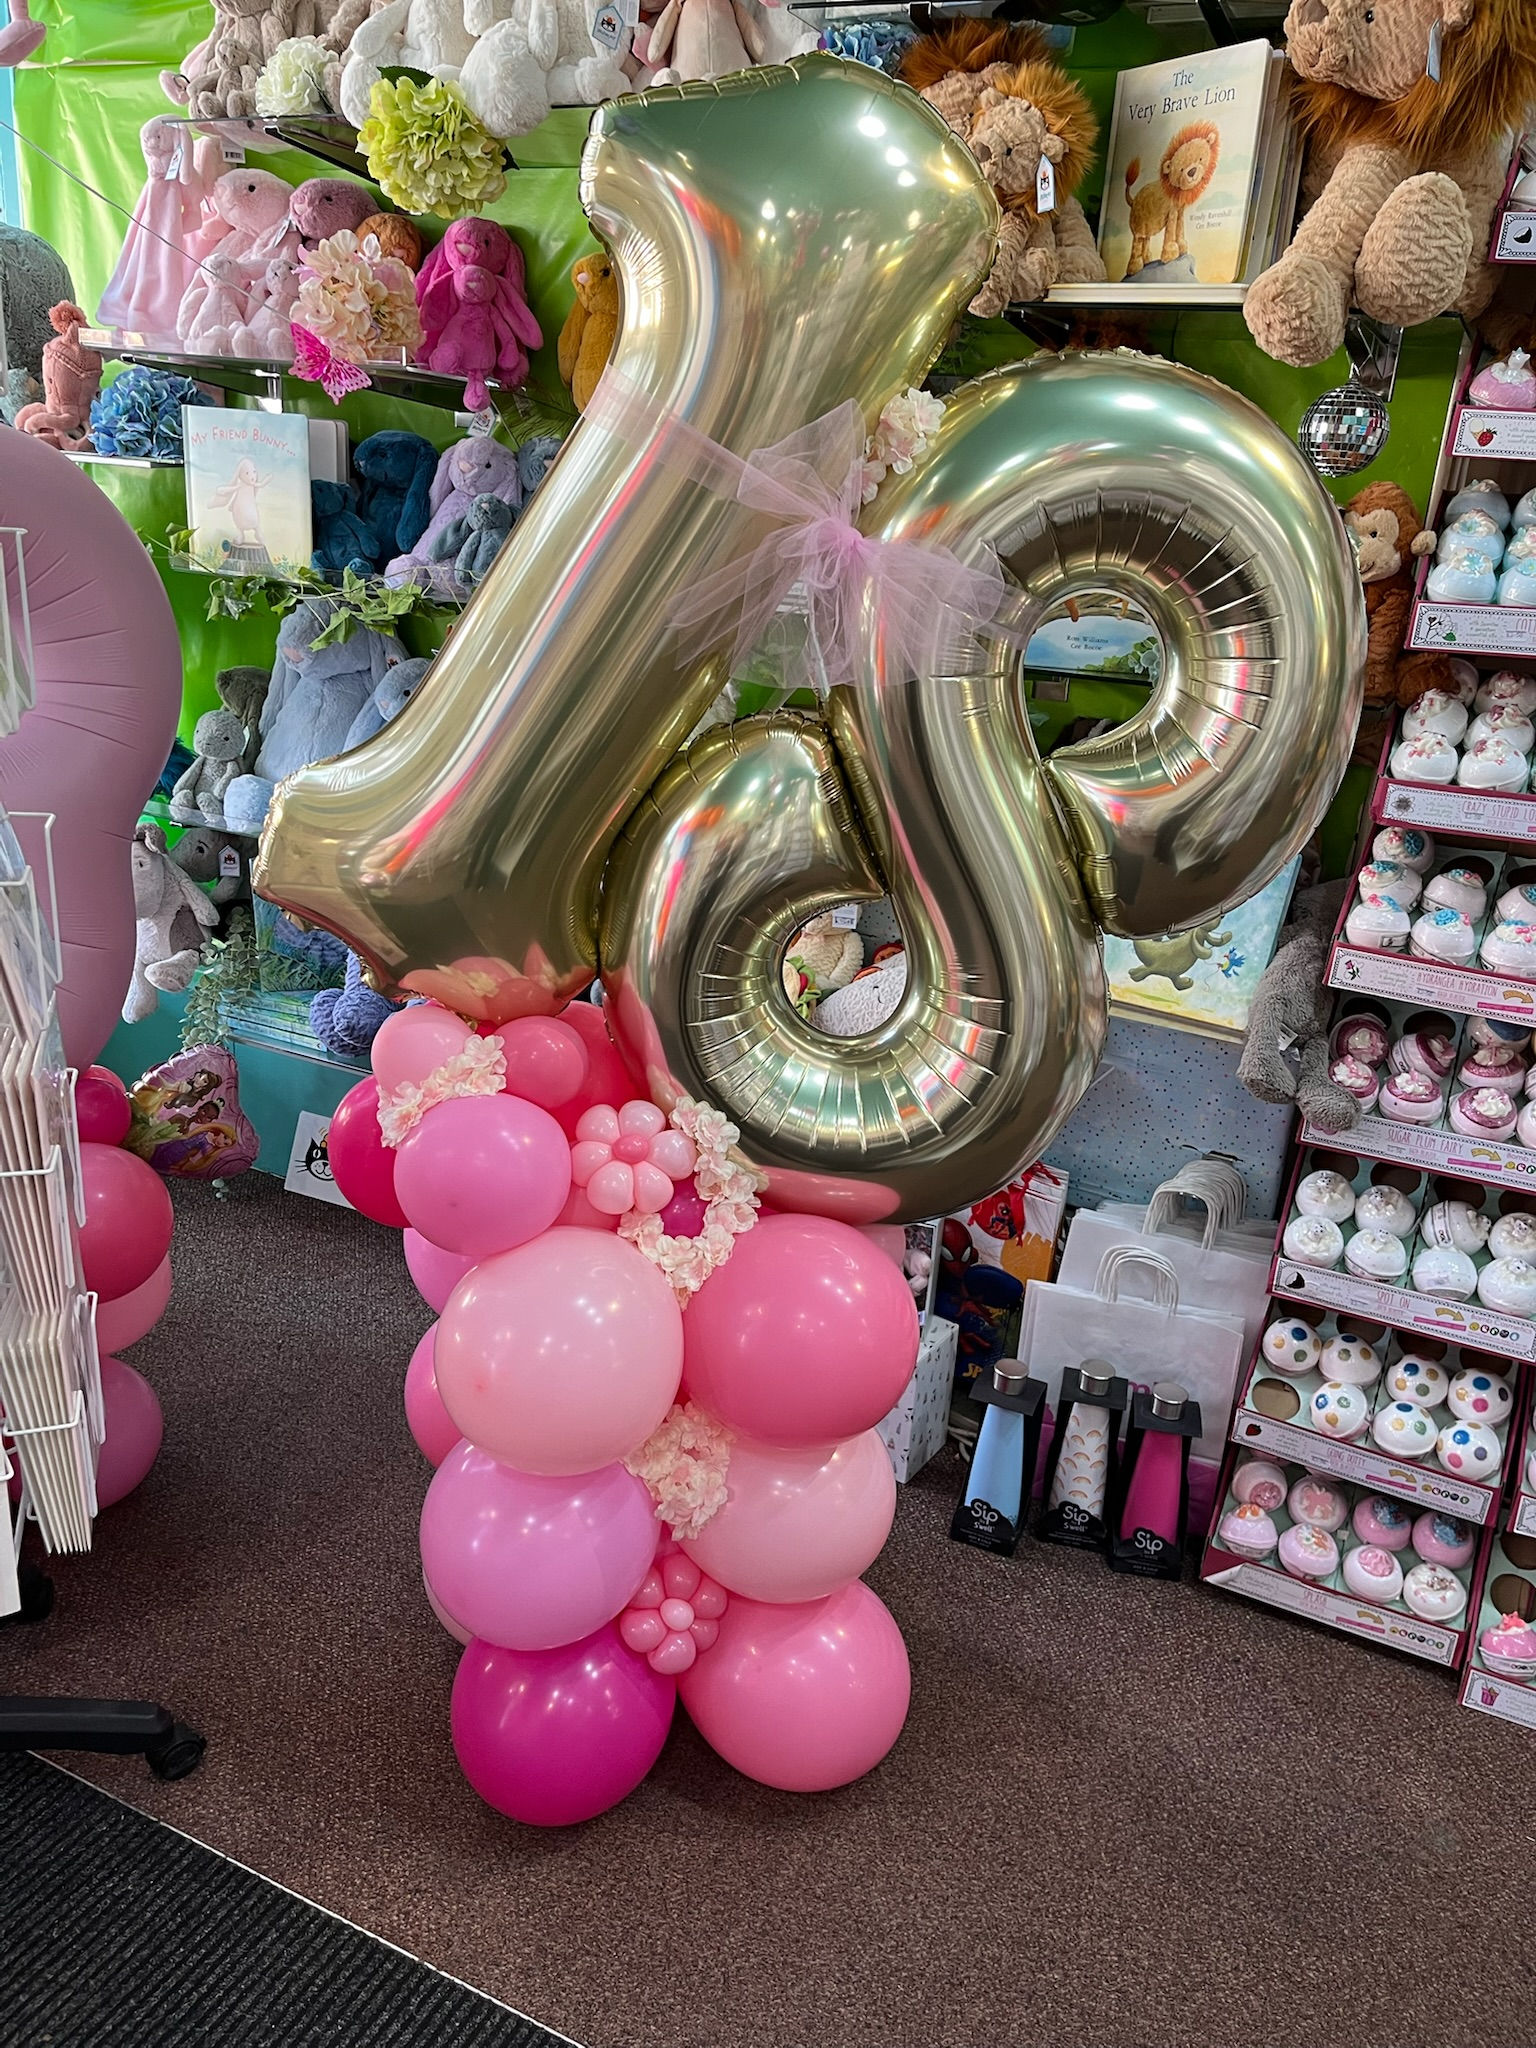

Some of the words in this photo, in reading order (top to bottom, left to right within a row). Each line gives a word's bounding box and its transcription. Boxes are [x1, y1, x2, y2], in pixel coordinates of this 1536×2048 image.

[1173, 70, 1194, 87] The
[1128, 104, 1157, 125] Very
[1162, 95, 1200, 114] Brave
[1204, 86, 1236, 106] Lion
[212, 426, 248, 441] FRIEND
[1492, 804, 1520, 819] STUPID
[1523, 808, 1536, 822] LO
[1416, 971, 1455, 988] HYDRANGEA
[1458, 979, 1499, 997] HYDRATION
[1387, 1128, 1411, 1145] SUGAR
[1415, 1133, 1436, 1149] PLUM
[1440, 1139, 1464, 1155] FAIRY
[1377, 1290, 1395, 1304] SPOT
[1399, 1295, 1411, 1309] ON
[971, 1501, 998, 1525] Sip
[1063, 1505, 1089, 1525] Sip
[1135, 1531, 1163, 1555] Sip
